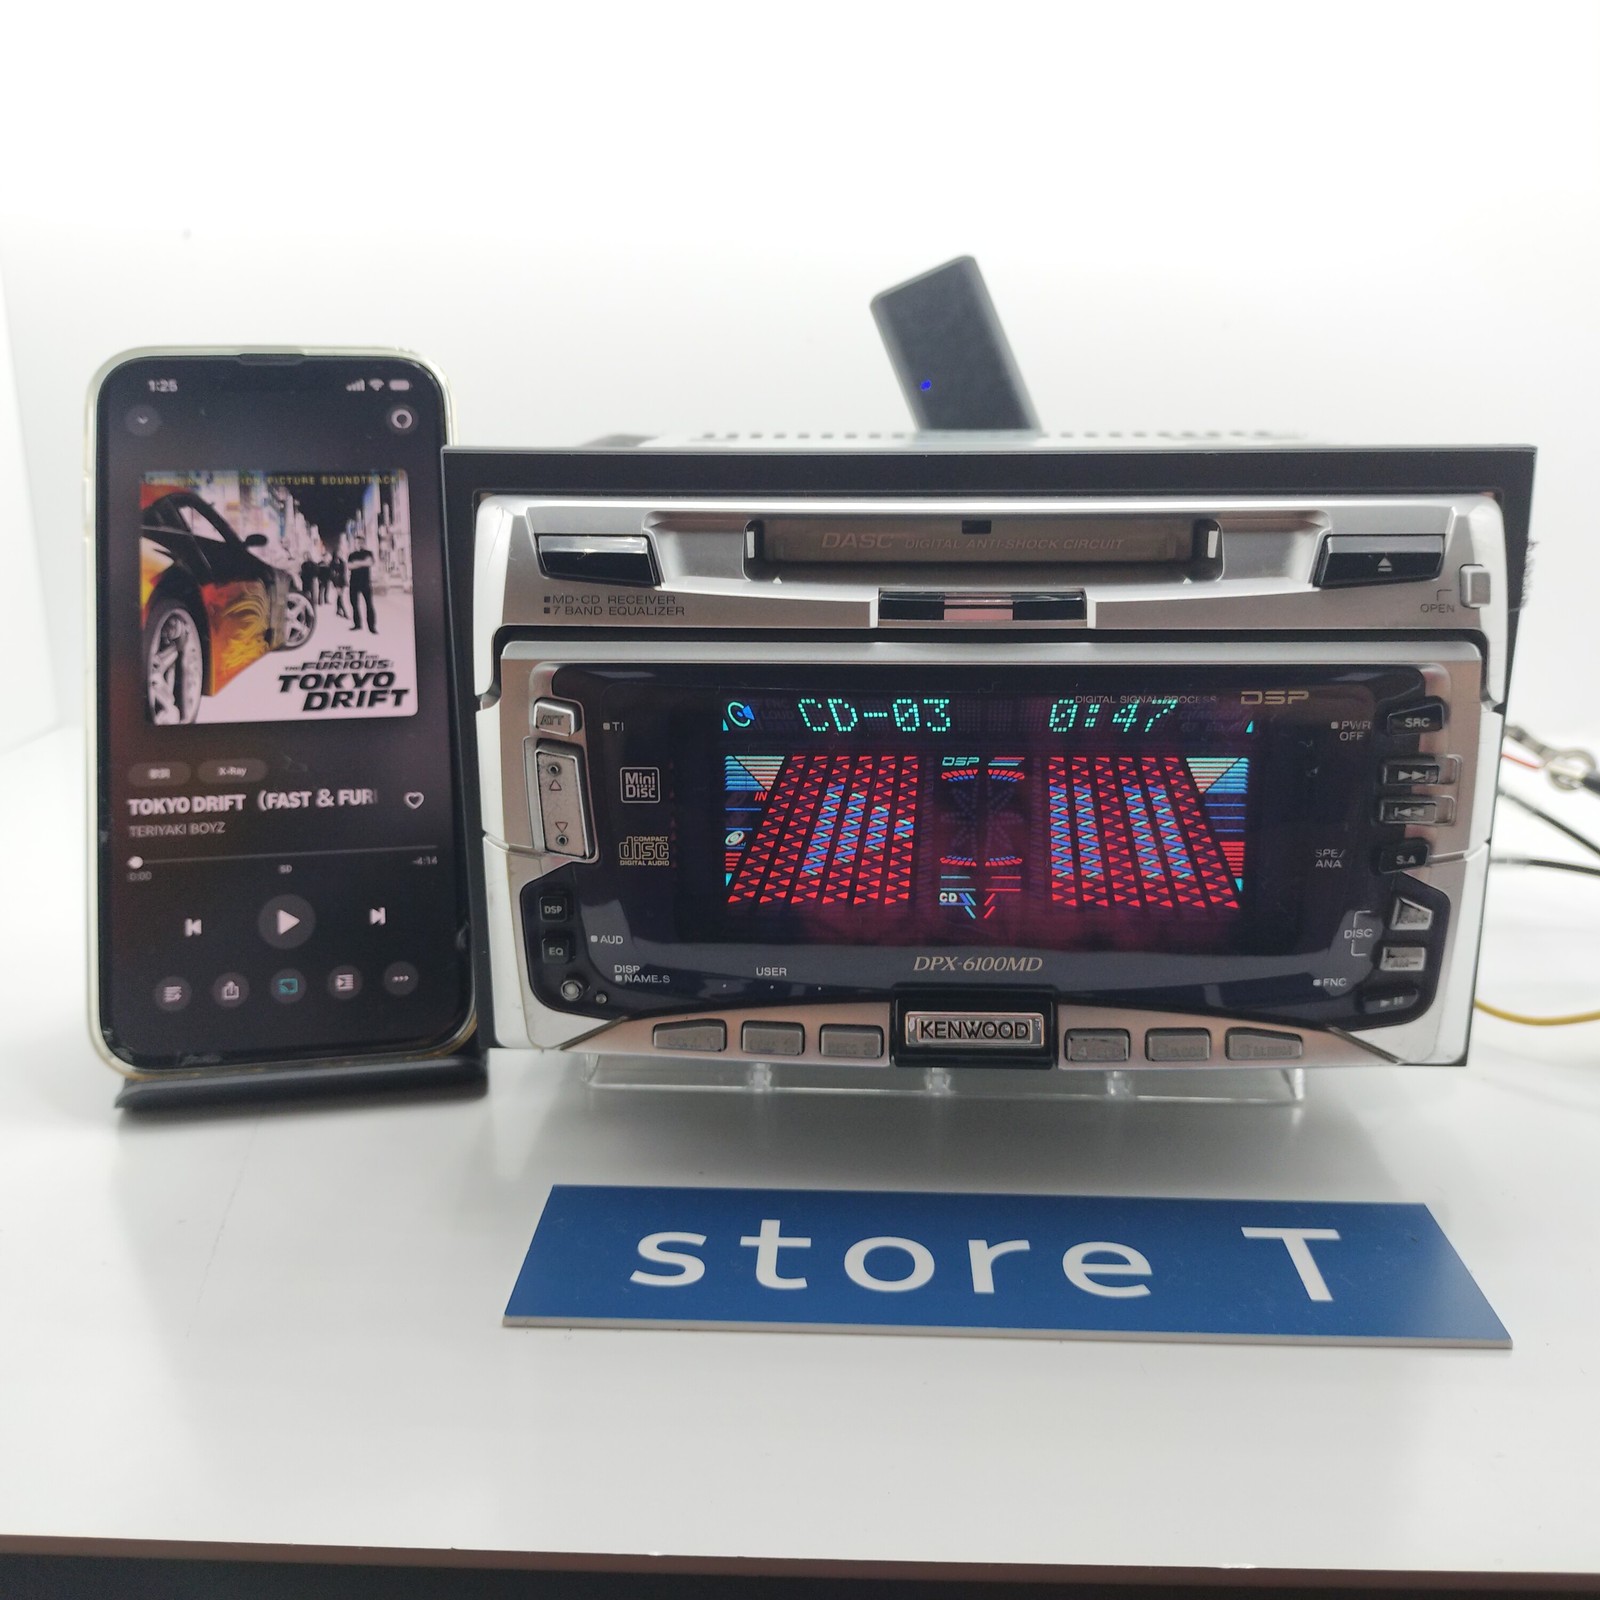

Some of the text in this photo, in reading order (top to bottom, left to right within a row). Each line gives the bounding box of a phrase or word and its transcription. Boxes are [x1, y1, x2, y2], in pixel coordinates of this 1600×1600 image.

[267, 475, 316, 485] PICTURE
[821, 532, 1124, 549] DASC DIGITAL ANTI-SHOCK CIRCUIT
[607, 595, 676, 605] RECEIVER
[553, 606, 685, 616] 7 BAND EQUALIZER
[1420, 603, 1454, 613] OPEN
[319, 650, 366, 660] FAST
[278, 671, 395, 693] TOKYO
[302, 688, 409, 711] DRIFT
[1075, 695, 1116, 704] DIGITAL
[1120, 695, 1157, 704] SIGNAL
[1240, 690, 1309, 705] DSP
[798, 698, 1178, 733] CD-03 0:47
[1341, 721, 1371, 730] PWR
[1404, 717, 1431, 728] SRC
[1339, 731, 1364, 741] OFF
[942, 757, 980, 766] DSP
[218, 766, 247, 777] X-Ray
[625, 772, 655, 785] Mini
[626, 785, 656, 798] Disc
[754, 792, 768, 801] IN
[128, 797, 190, 815] TOKYO
[191, 794, 246, 813] DRIFT
[257, 790, 312, 811] (FAST
[315, 788, 335, 807] &
[129, 821, 226, 837] TERIYAKI BOYZ
[1315, 859, 1342, 869] ANA
[939, 892, 957, 902] CD
[544, 905, 563, 915] DSP
[1344, 928, 1373, 939] DISC
[600, 935, 624, 945] AUD
[549, 946, 564, 956] EQ
[614, 964, 640, 974] DISP
[913, 956, 1043, 972] DPX-6100MD
[755, 966, 787, 976] USER
[624, 974, 670, 984] NAME.S
[1323, 978, 1347, 987] FNC
[920, 1020, 1029, 1040] KENWOOD
[629, 1218, 1341, 1302] store T
